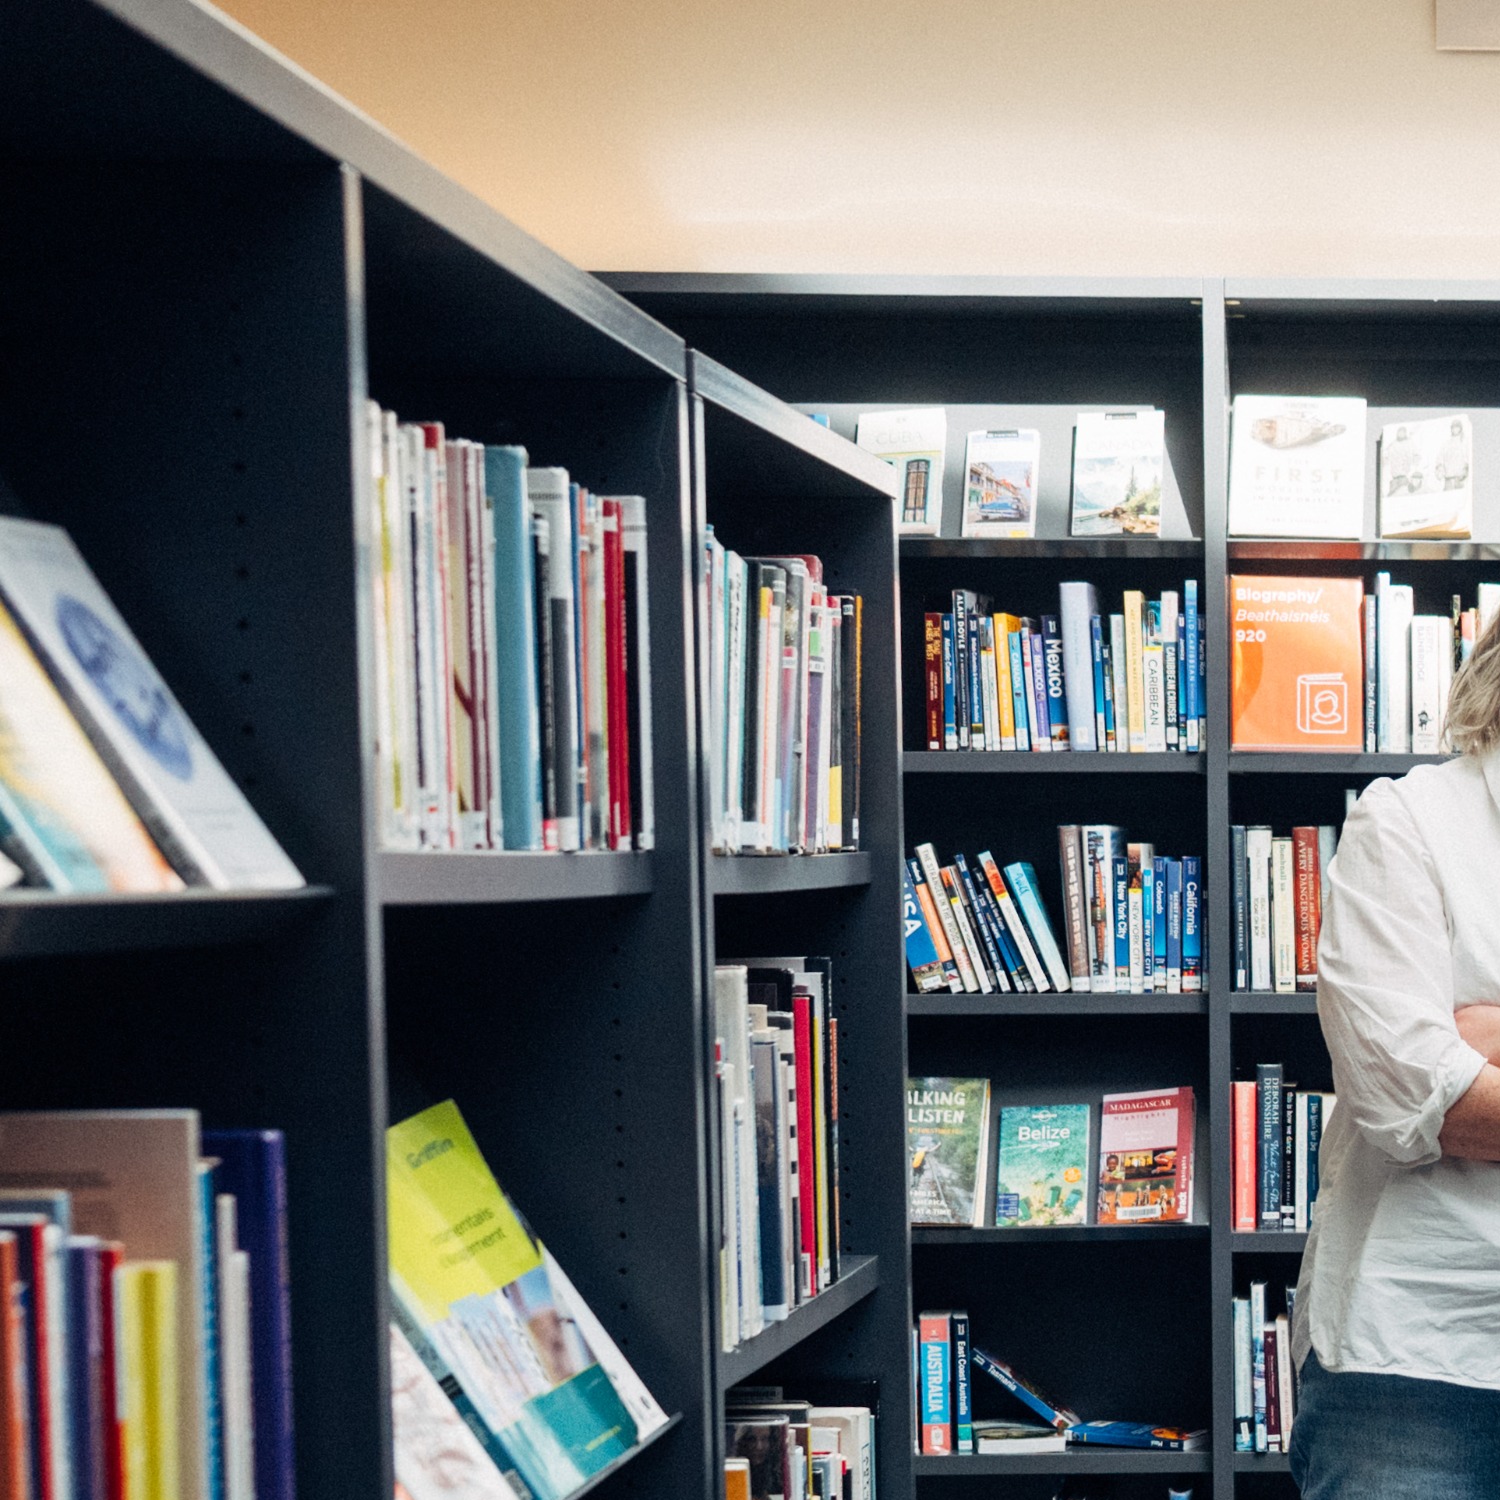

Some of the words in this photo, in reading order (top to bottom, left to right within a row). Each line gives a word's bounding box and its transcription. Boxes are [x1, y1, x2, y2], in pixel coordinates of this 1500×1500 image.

[957, 595, 966, 618] ALAN
[1235, 587, 1323, 605] Biography/
[1188, 609, 1197, 631] WILD
[957, 621, 966, 650] DOYLE
[1235, 629, 1267, 643] 920
[1045, 639, 1063, 698] Mexico
[1166, 646, 1177, 689] CARIBBEAN
[1188, 633, 1197, 682] CARIBBEAN
[1013, 652, 1021, 689] CANADA
[1035, 655, 1044, 691] MEXICO
[1148, 658, 1160, 726] CARIBBEAN
[1166, 690, 1177, 723] CRUISES
[1299, 849, 1307, 870] VERY
[1117, 881, 1128, 901] New
[1155, 880, 1164, 915] Colorado
[1117, 902, 1128, 921] York
[1132, 901, 1141, 922] NEW
[1186, 881, 1198, 936] California
[1300, 874, 1309, 932] DANGEROUS
[1117, 921, 1128, 940] City
[1132, 923, 1141, 945] YORK
[1132, 947, 1141, 968] CITY
[1302, 937, 1311, 972] WOMAN
[1109, 1098, 1174, 1113] MADAGASCAR
[1263, 1077, 1272, 1139] DEVONSHIRE
[1271, 1077, 1280, 1125] DEBORAH
[1286, 1092, 1294, 1103] this
[908, 1108, 966, 1124] LISTEN
[1286, 1110, 1294, 1123] how
[1018, 1125, 1072, 1142] Belize
[1286, 1136, 1294, 1155] dance
[957, 1341, 968, 1359] East
[927, 1343, 944, 1413] AUSTRALIA
[957, 1360, 967, 1381] Coast
[958, 1382, 967, 1416] Australia
